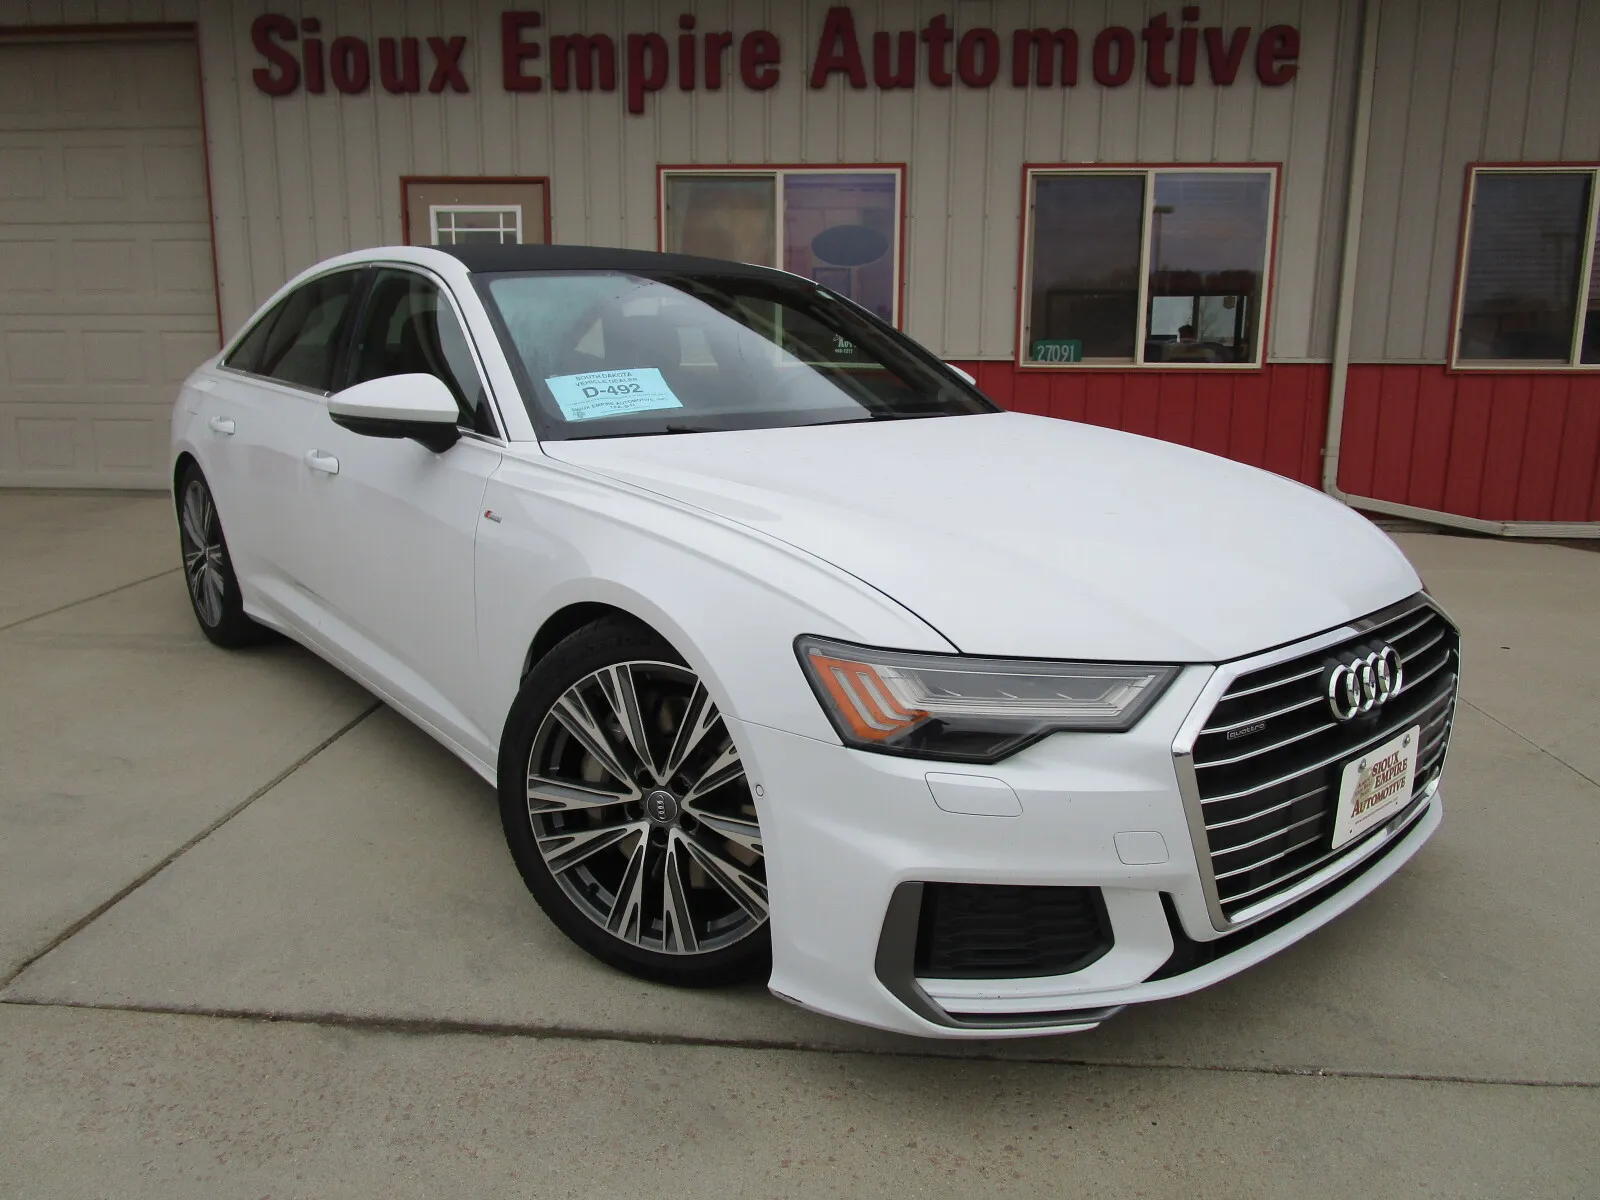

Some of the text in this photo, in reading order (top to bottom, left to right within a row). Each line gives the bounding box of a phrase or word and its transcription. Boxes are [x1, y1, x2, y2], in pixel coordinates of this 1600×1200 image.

[251, 6, 1300, 115] Sioux Empire Automotive
[1037, 344, 1075, 362] 27091
[575, 371, 633, 381] SOUTH DAKOTA
[575, 379, 608, 387] VEHICLE
[582, 383, 643, 399] D-492
[1229, 723, 1265, 738] quattro
[1371, 751, 1399, 777] SIOUX
[1374, 758, 1408, 789] EMPIRE
[1351, 776, 1406, 819] AUTOMOTIVE
